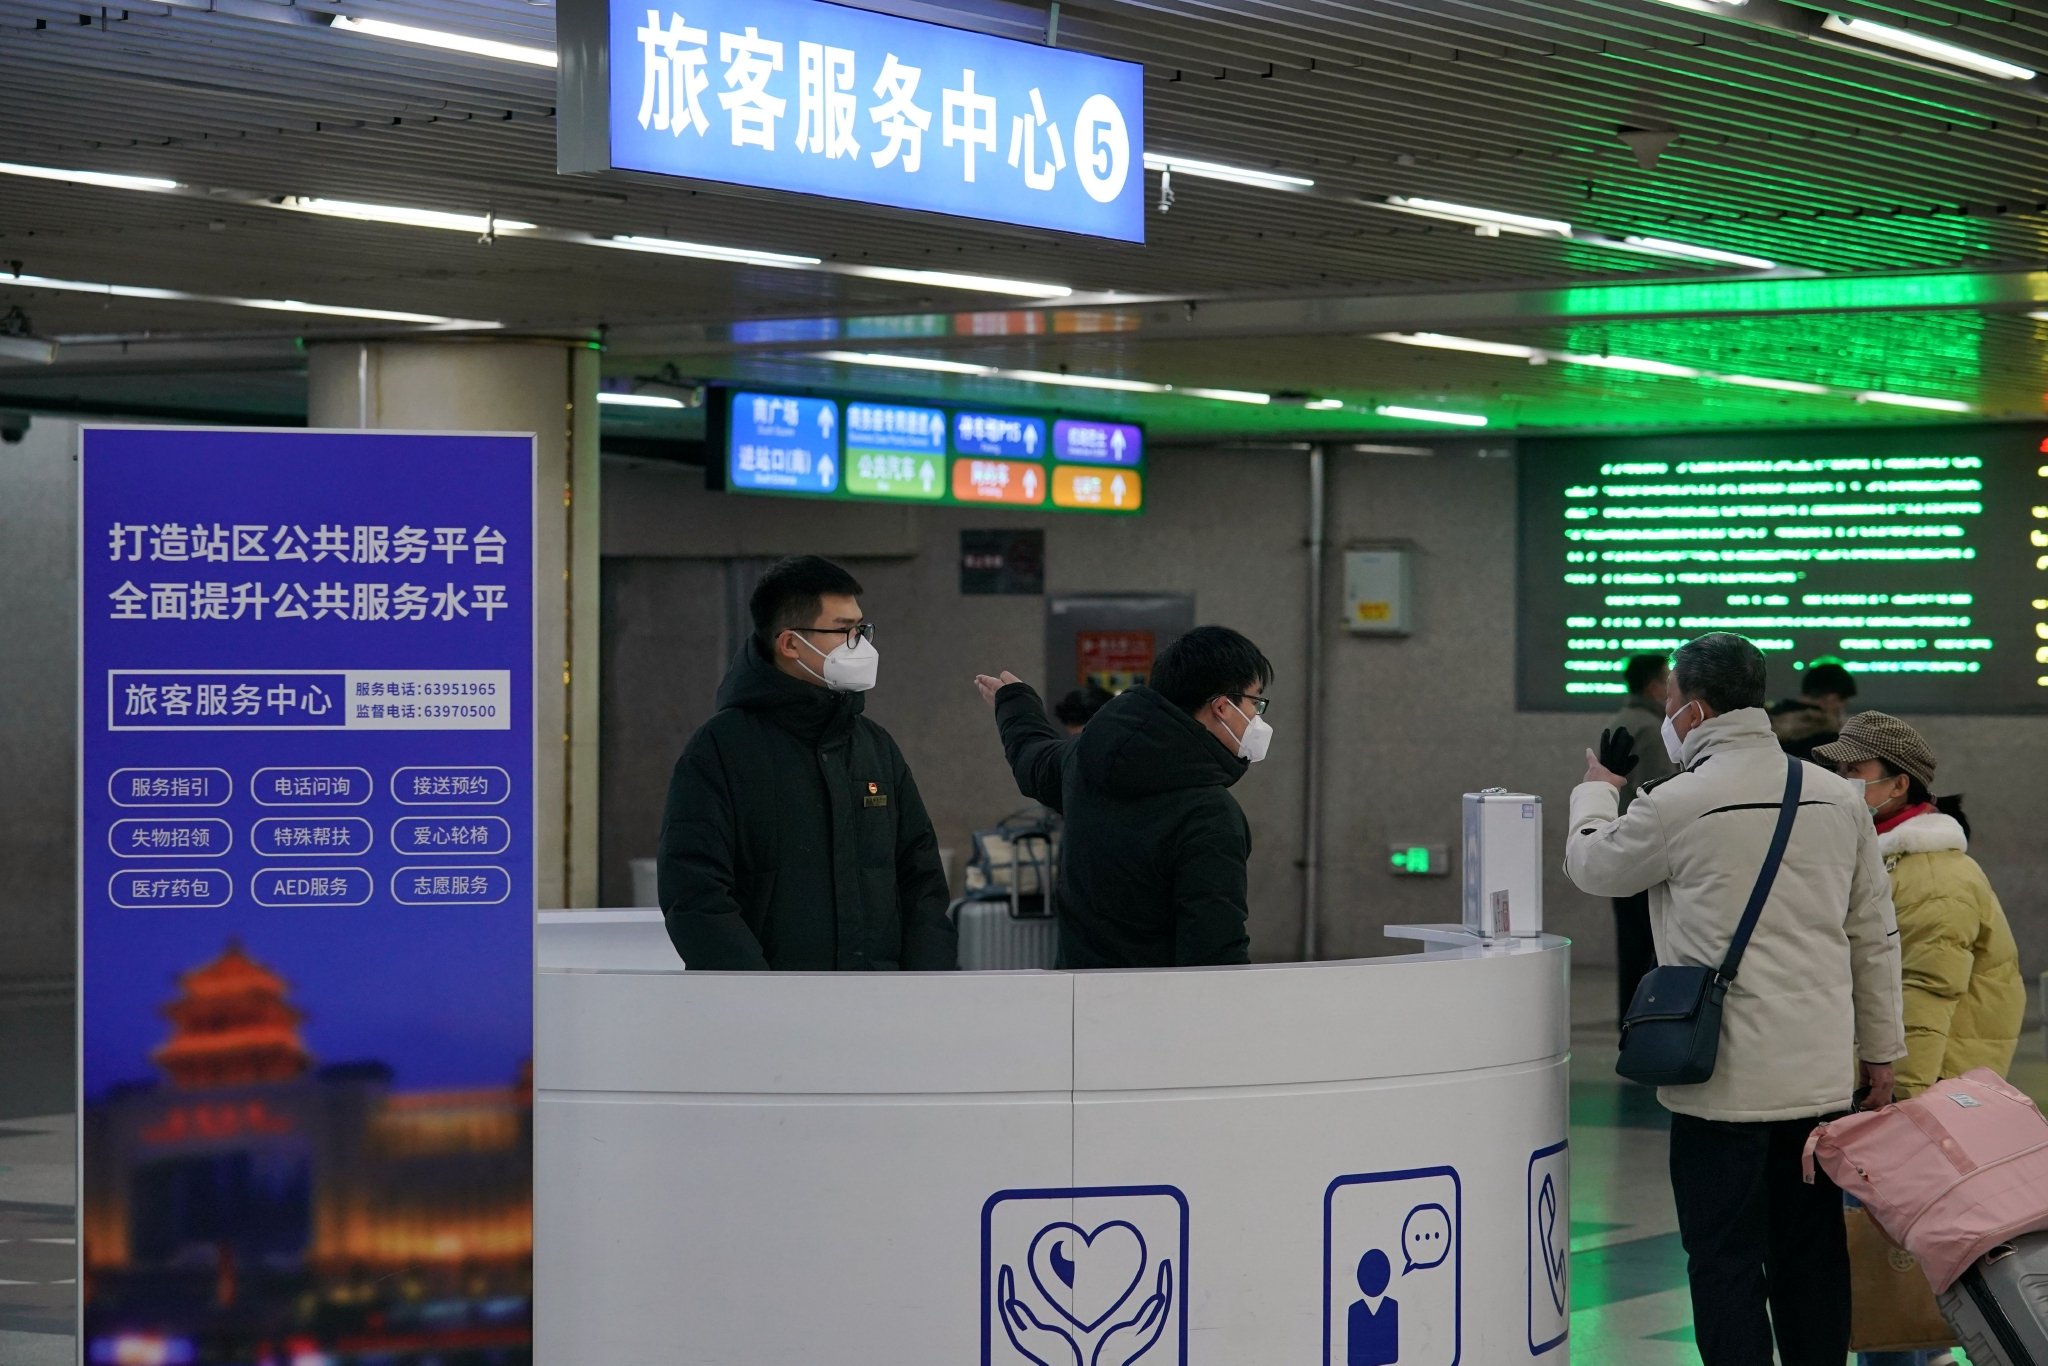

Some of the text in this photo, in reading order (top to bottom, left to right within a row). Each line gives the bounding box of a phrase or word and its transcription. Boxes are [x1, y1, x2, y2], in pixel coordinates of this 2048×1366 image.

[637, 9, 1115, 191] 旅客服务中心 5
[108, 522, 507, 565] 打造站区公共服务平台
[108, 580, 509, 622] 全面提升公共服务水平
[124, 683, 333, 716] 旅客服务中心
[131, 777, 209, 798] 服务指引
[274, 776, 351, 796] 电话问询
[413, 776, 488, 795] 接送预约
[131, 828, 210, 848] 失物招领
[274, 826, 351, 846] 特殊帮扶
[413, 825, 489, 845] 爱心轮椅
[131, 879, 210, 899] 医疗药包
[273, 877, 348, 897] AED服务
[413, 875, 489, 895] 志愿服务
